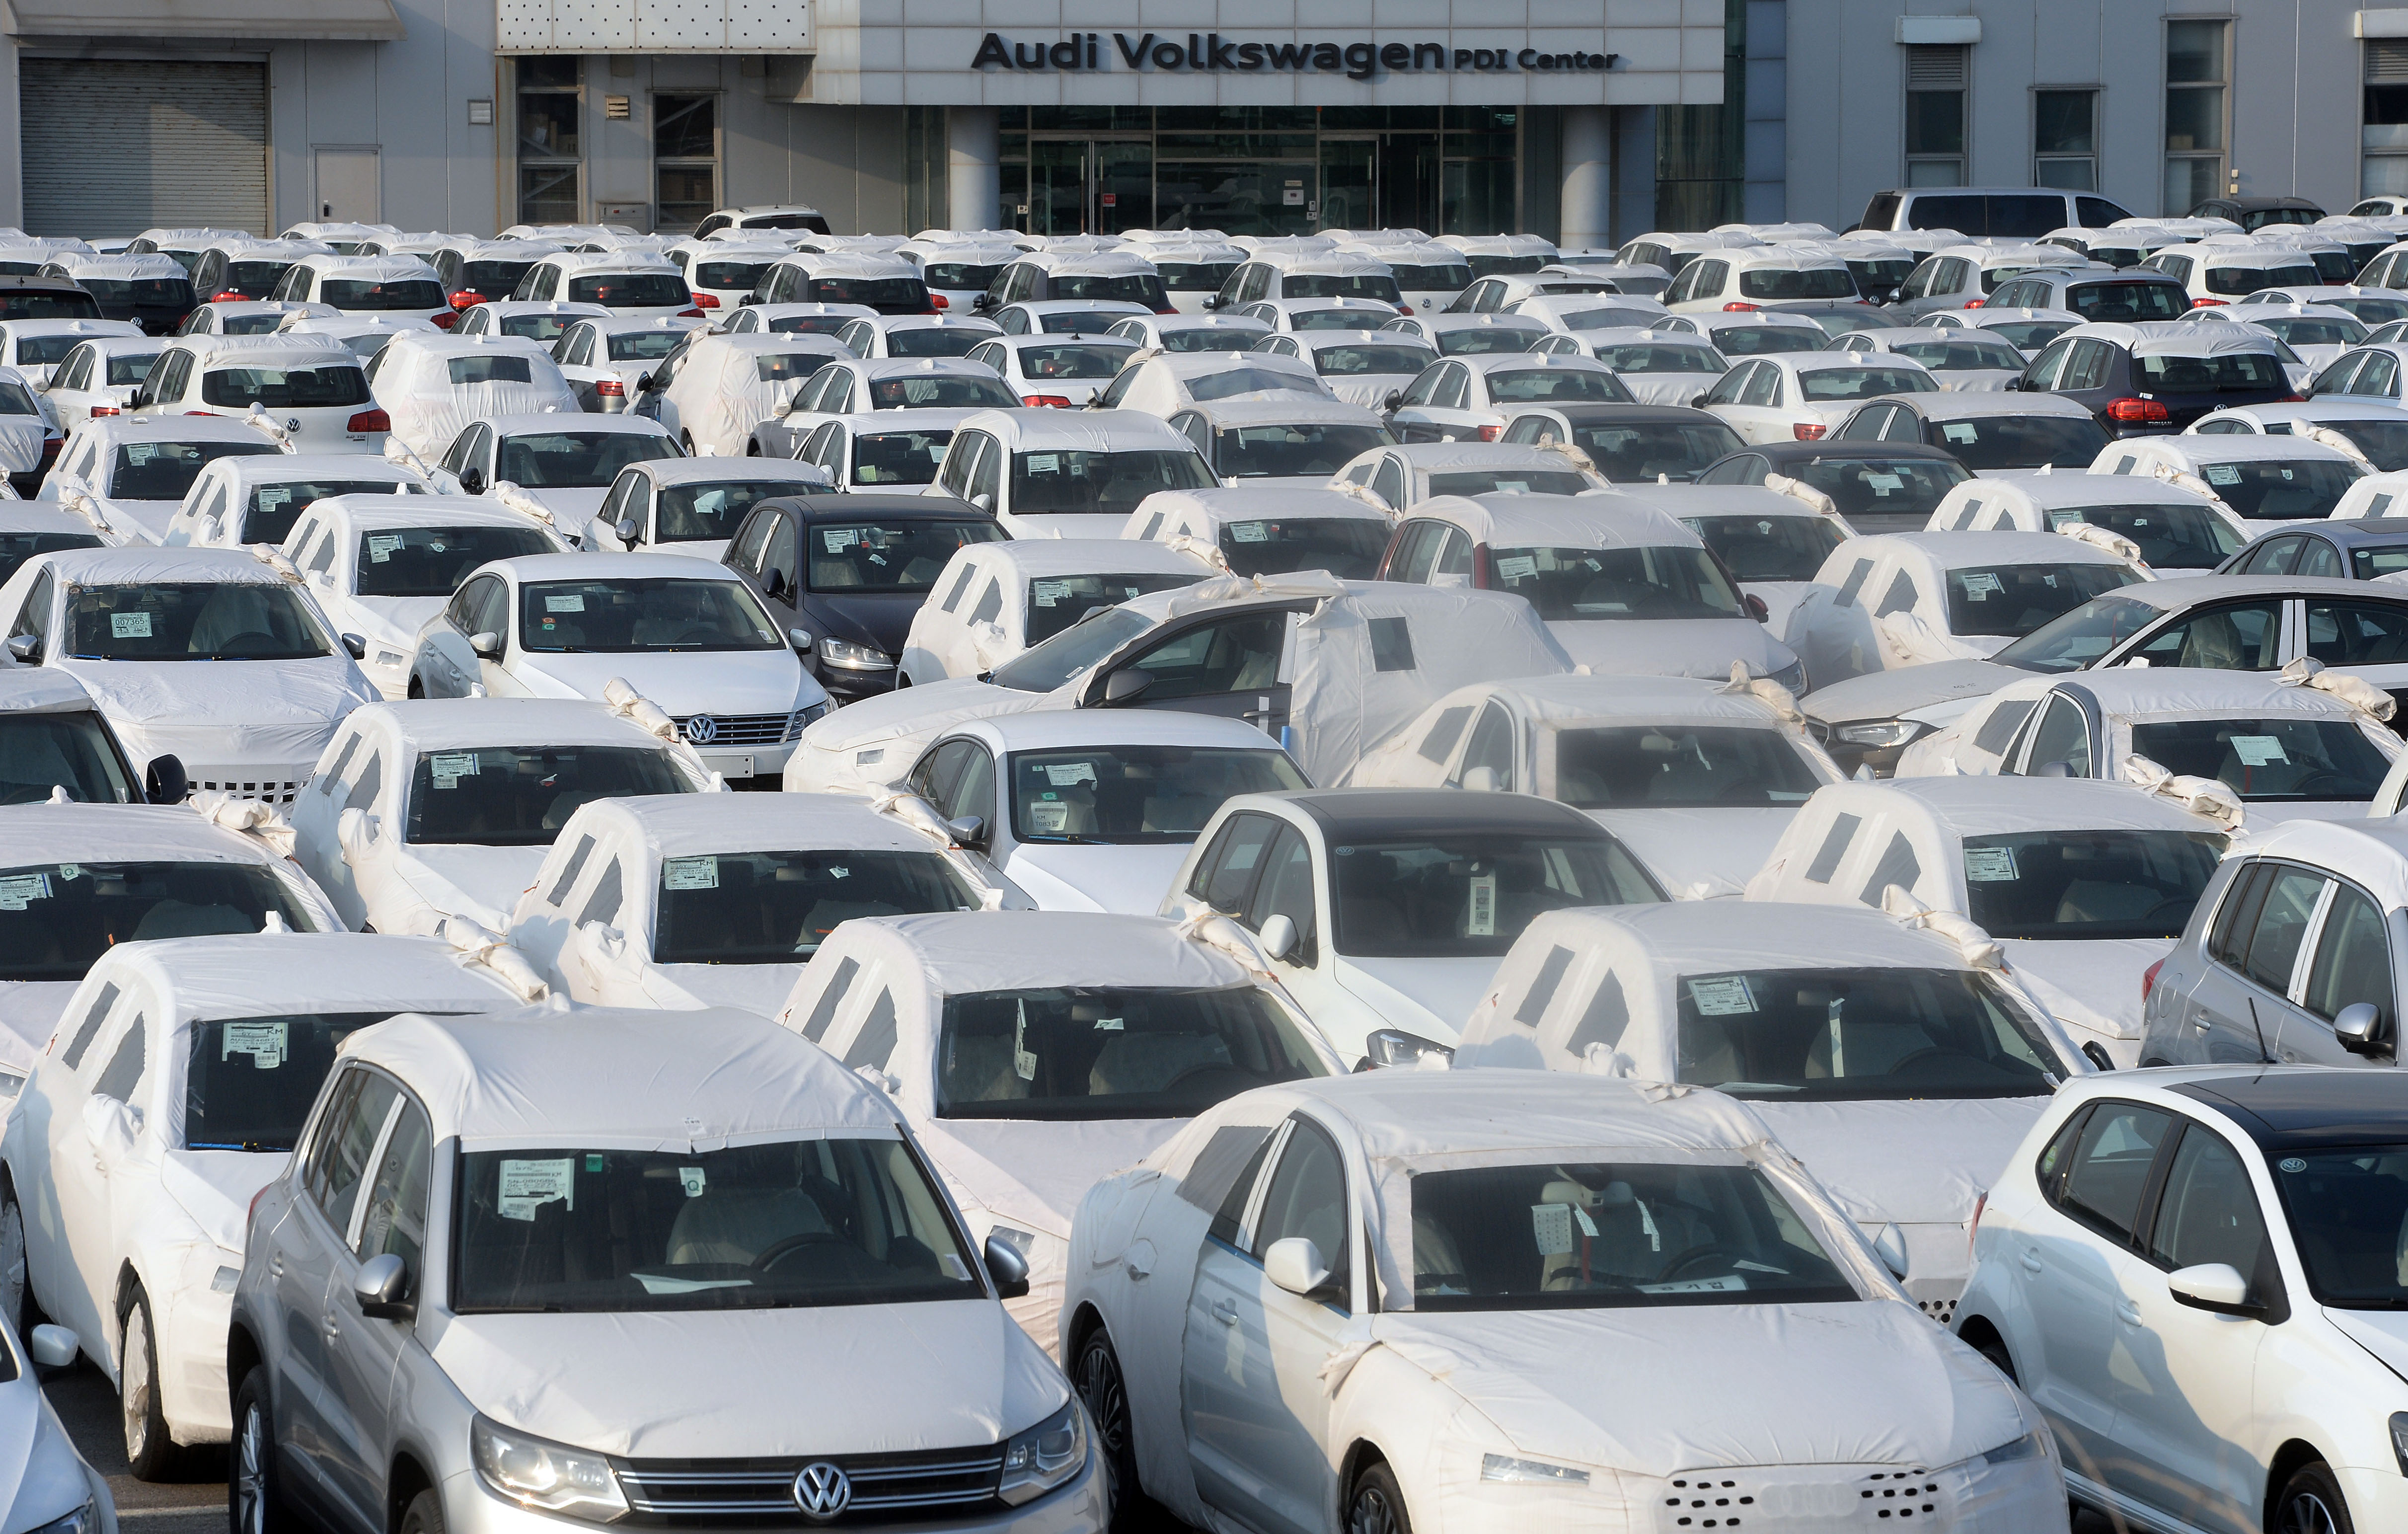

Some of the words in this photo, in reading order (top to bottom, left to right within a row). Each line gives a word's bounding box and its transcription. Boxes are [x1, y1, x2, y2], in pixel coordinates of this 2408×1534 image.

[971, 33, 1096, 69] Audi
[1113, 33, 1444, 78] Volkswagen
[1454, 49, 1508, 70] PDI
[1517, 48, 1618, 70] Center
[64, 868, 75, 876] Q
[687, 1180, 699, 1192] Q
